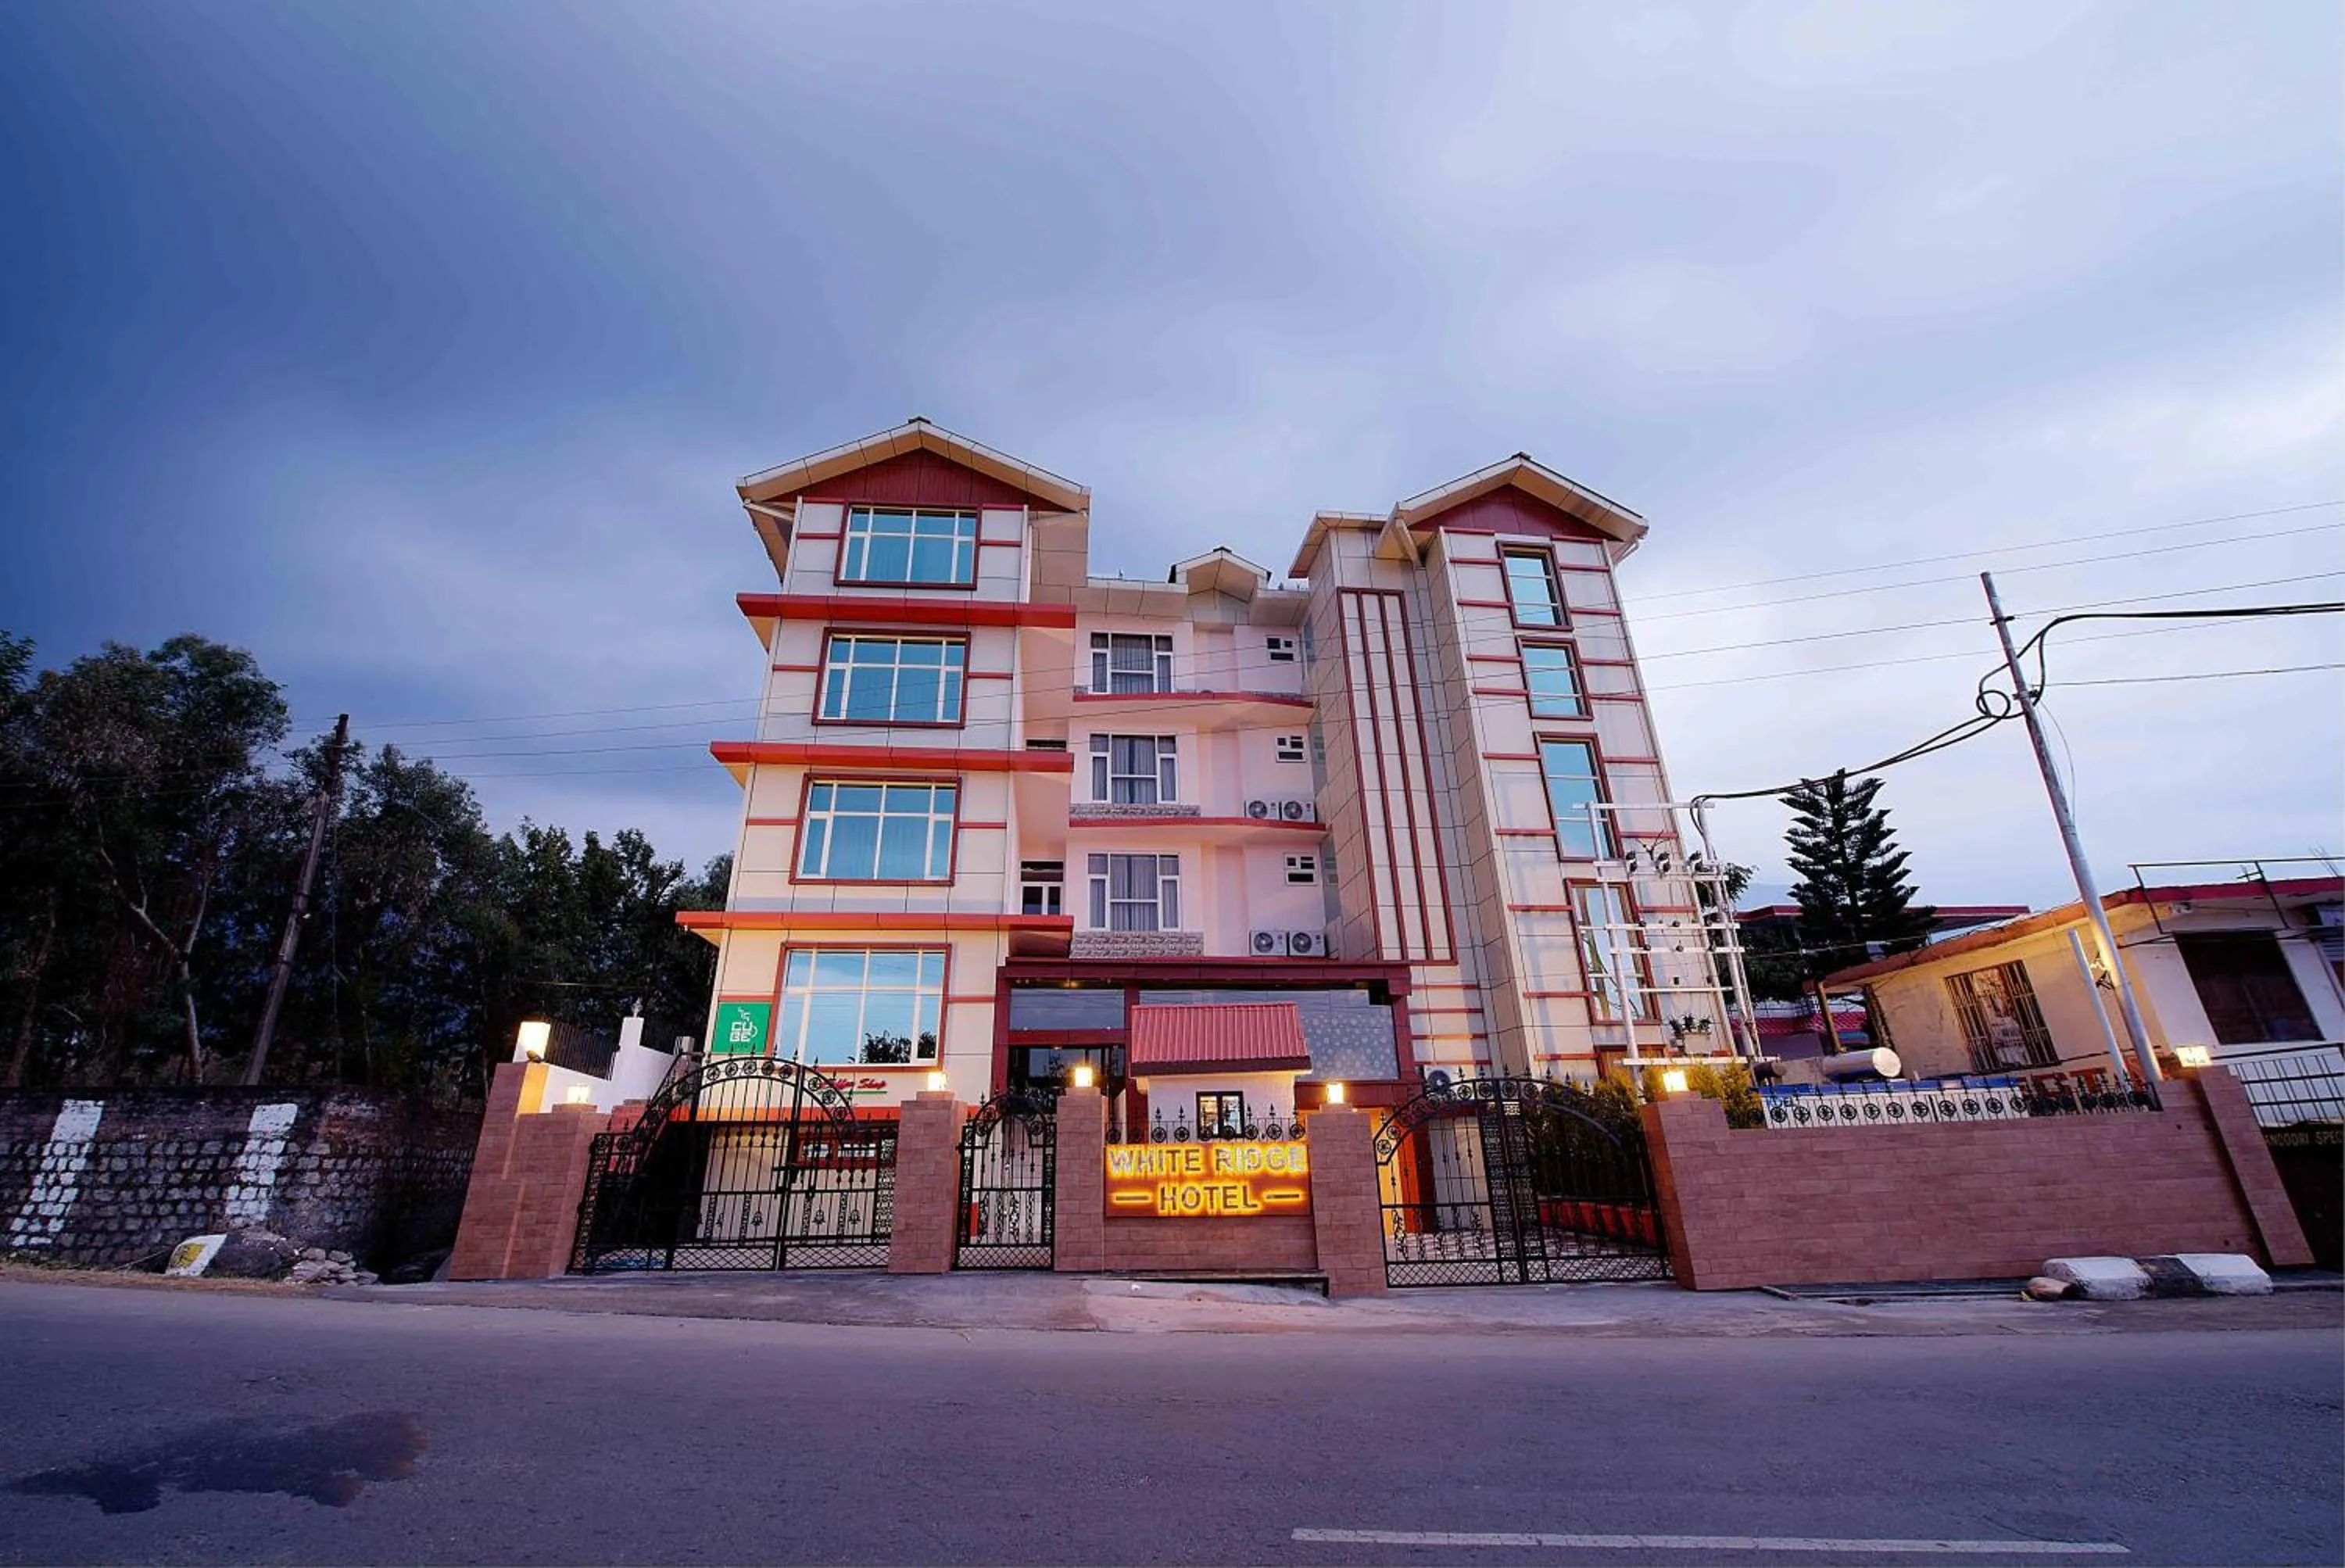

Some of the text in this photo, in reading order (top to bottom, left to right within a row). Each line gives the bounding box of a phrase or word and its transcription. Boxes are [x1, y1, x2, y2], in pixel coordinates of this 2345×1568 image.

[1108, 1147, 1306, 1173] WHITE RIDGE
[1159, 1185, 1258, 1211] HOTEL
